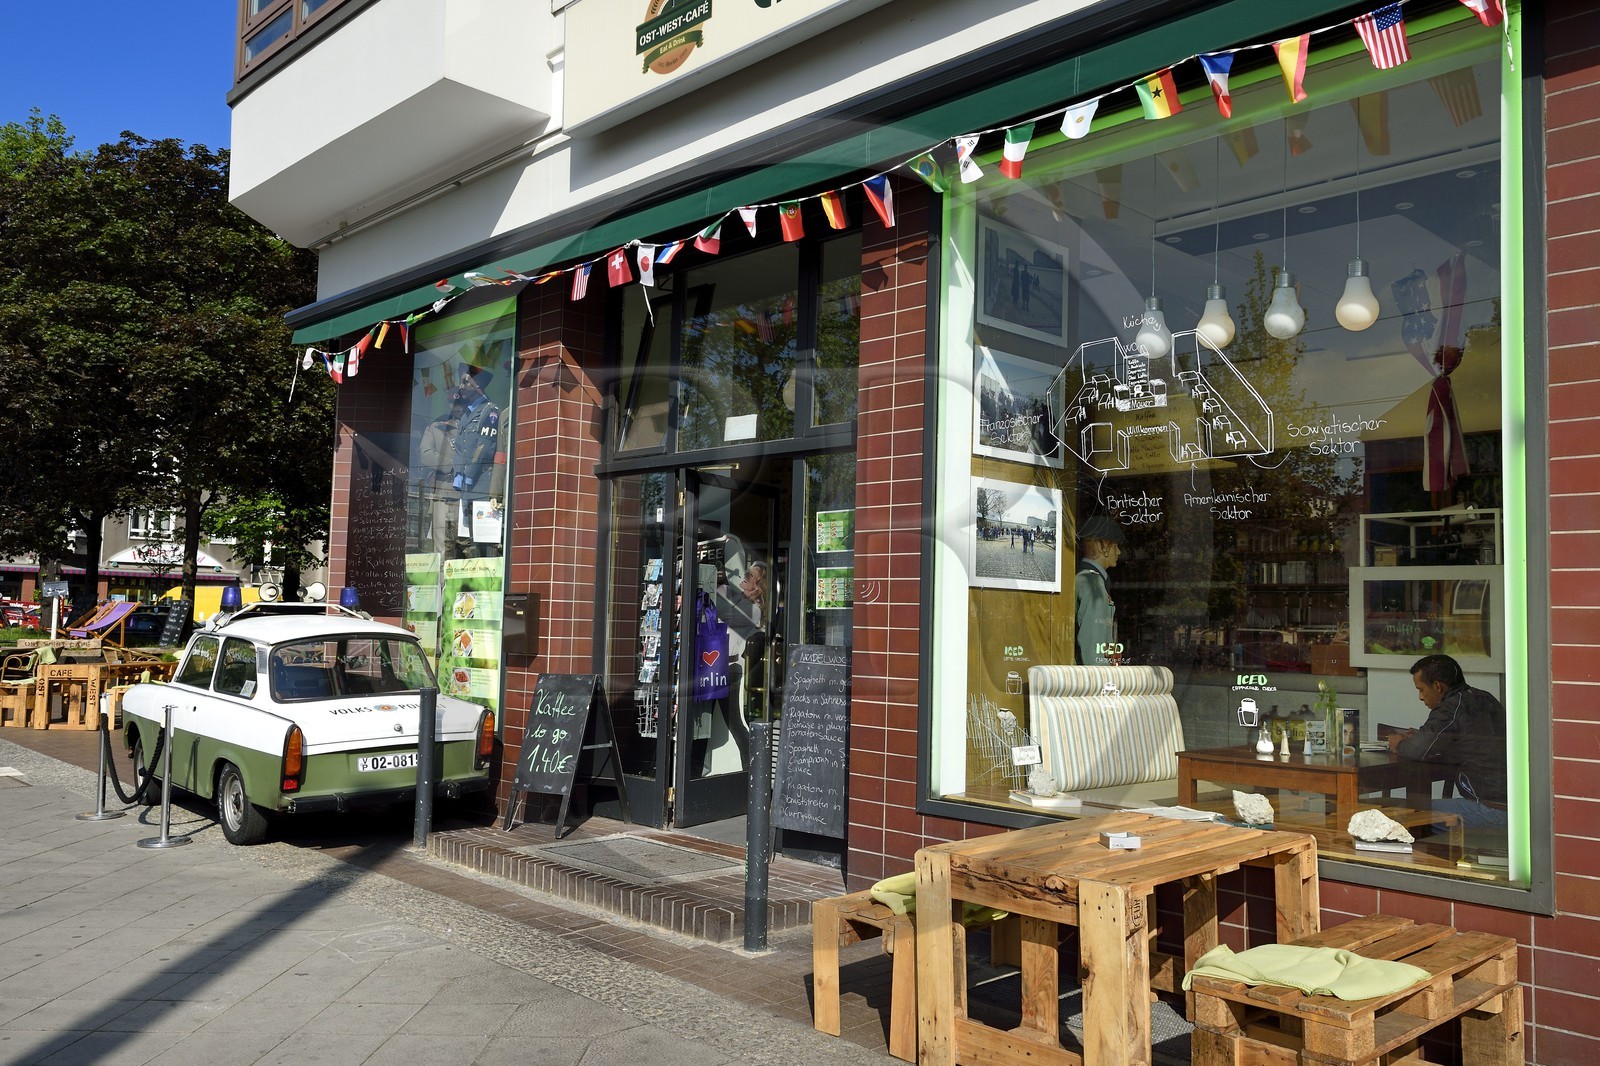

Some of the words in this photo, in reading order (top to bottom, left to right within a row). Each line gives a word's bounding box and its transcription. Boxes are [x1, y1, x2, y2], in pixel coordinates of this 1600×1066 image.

[659, 45, 668, 54] Eat
[673, 37, 686, 46] Drink
[1126, 425, 1168, 435] Willkommen
[1287, 413, 1387, 442] Sowjetischer
[1309, 437, 1361, 455] Sektor
[1106, 490, 1163, 510] Britischer
[1183, 486, 1271, 507] Amerikanischer
[1119, 508, 1163, 525] Sektor
[1210, 505, 1252, 520] Sektor
[1004, 645, 1024, 656] ICED
[1096, 642, 1124, 655] ICED
[50, 669, 73, 677] CAFE
[1237, 674, 1268, 686] ICED
[89, 678, 97, 706] WEST
[328, 706, 373, 716] VOLKS
[535, 688, 576, 718] Kaffee
[531, 724, 547, 738] to
[552, 727, 568, 745] go
